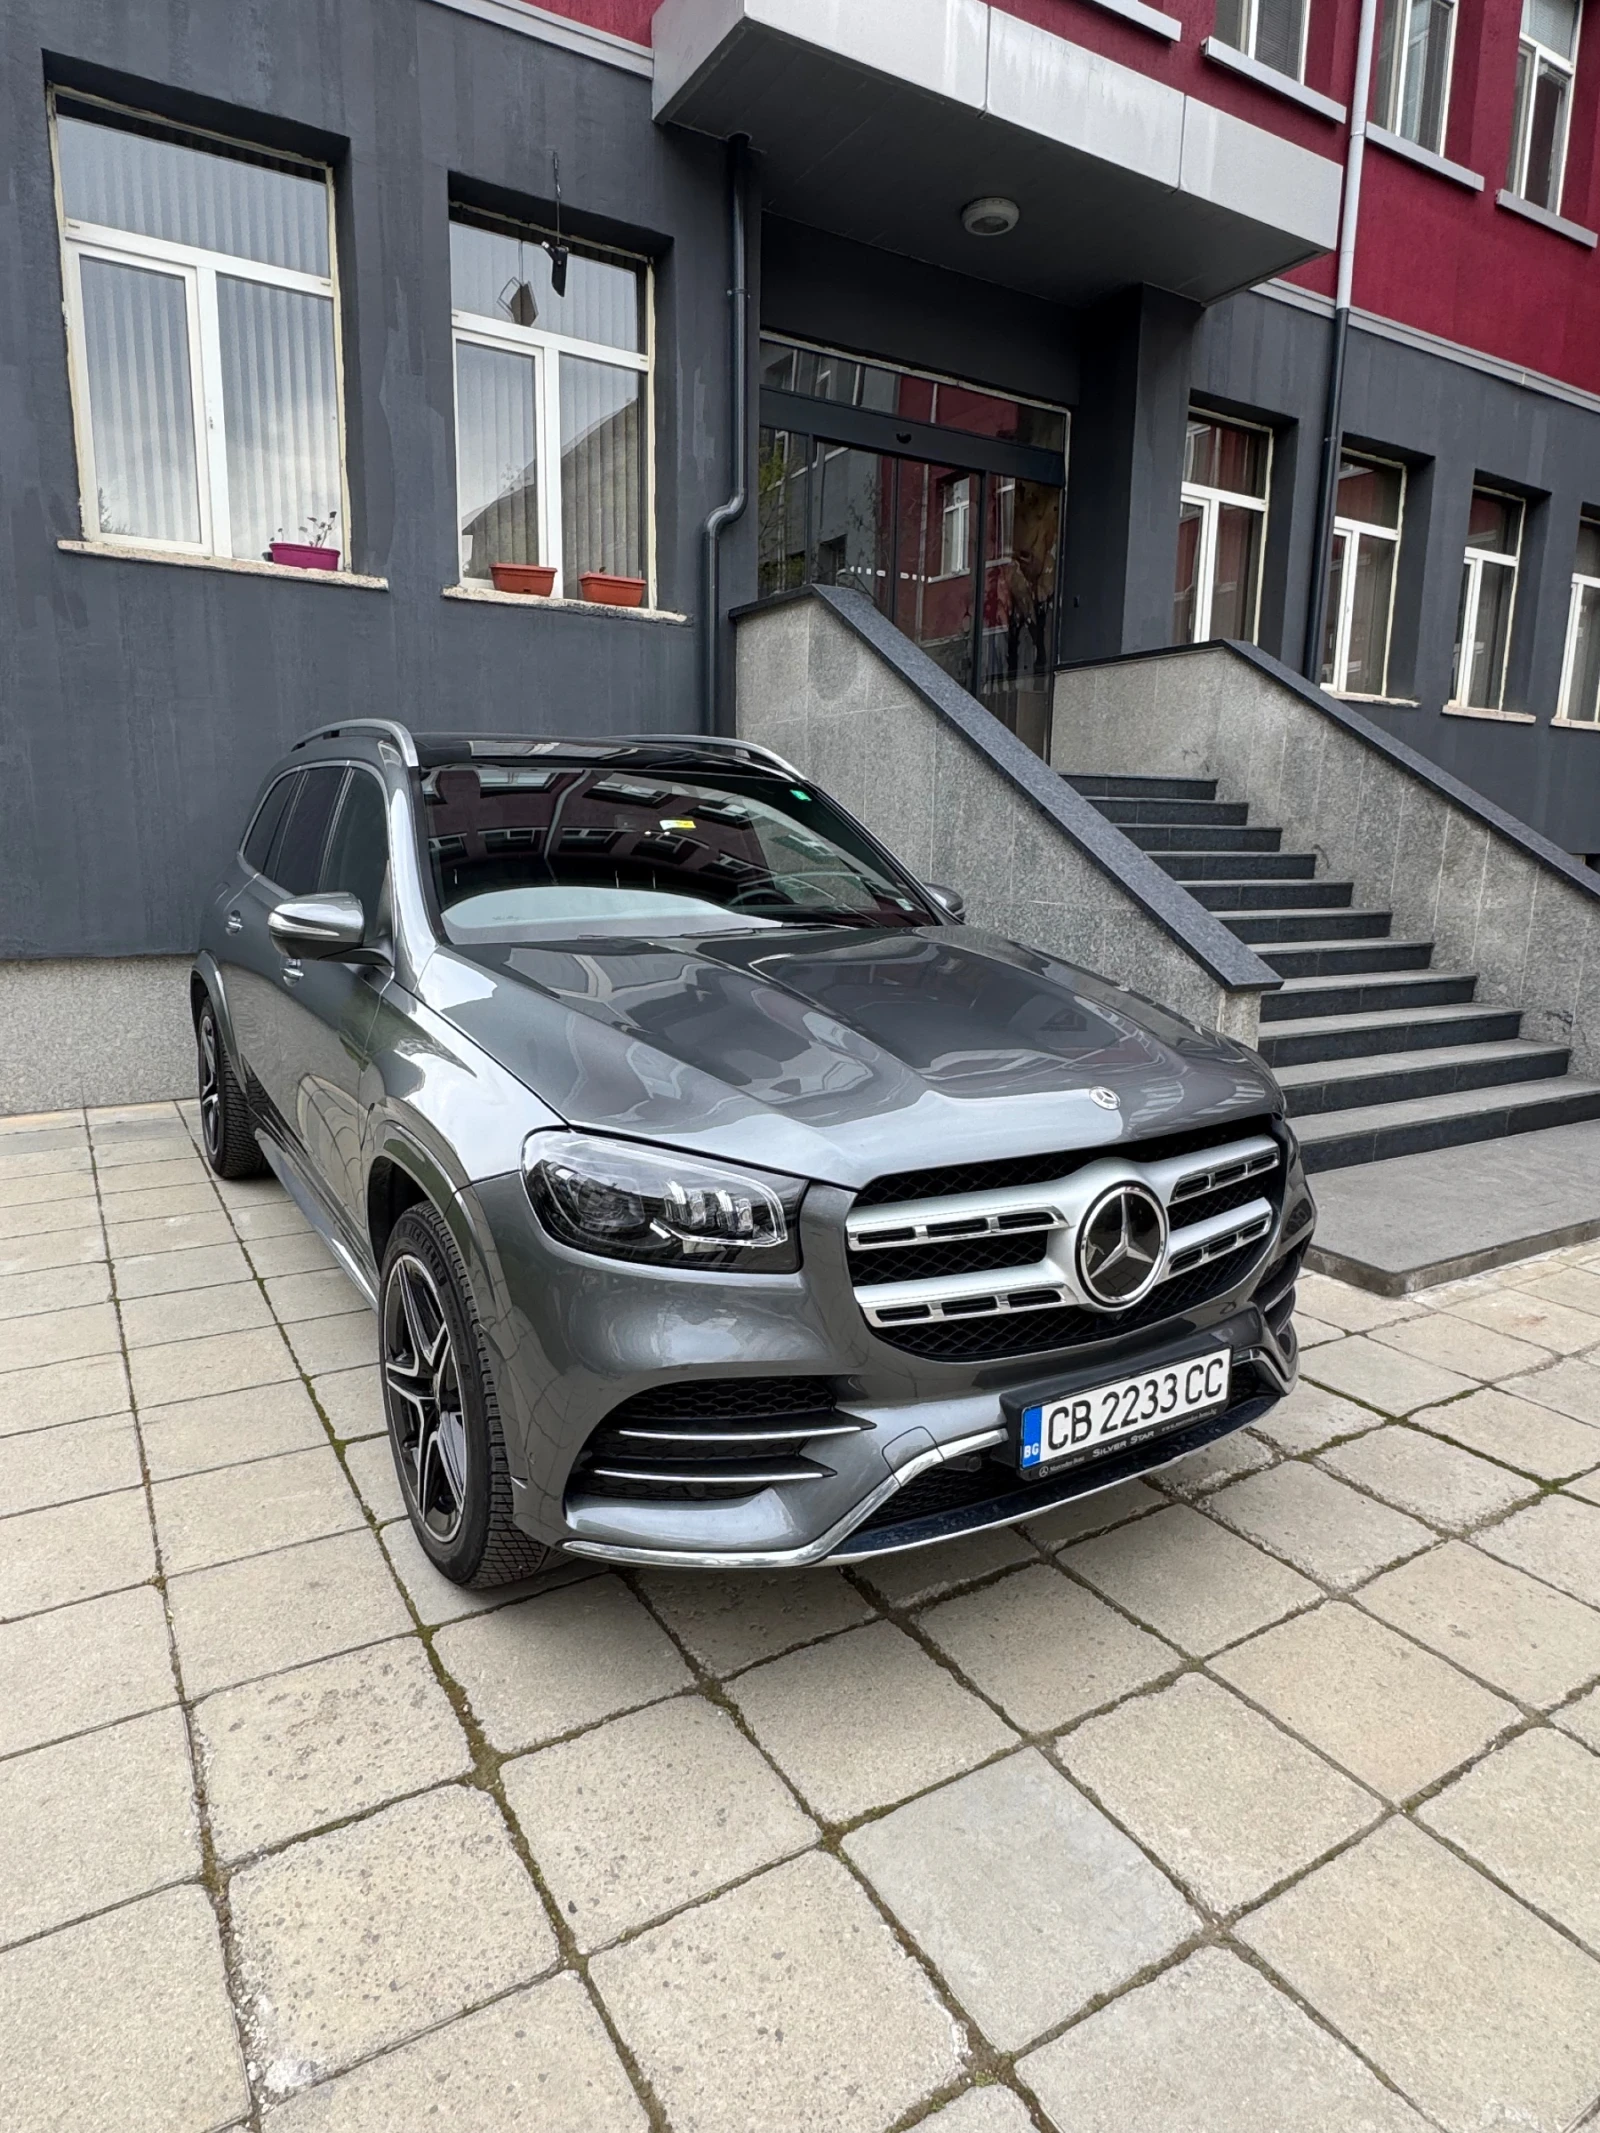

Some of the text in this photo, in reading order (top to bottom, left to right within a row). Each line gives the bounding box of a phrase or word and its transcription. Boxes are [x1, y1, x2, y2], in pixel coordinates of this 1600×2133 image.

[1048, 1400, 1092, 1450] CB
[1100, 1373, 1178, 1435] 2233
[1185, 1358, 1223, 1405] CC
[1024, 1442, 1040, 1458] BG
[1092, 1430, 1155, 1458] SILVER STAR
